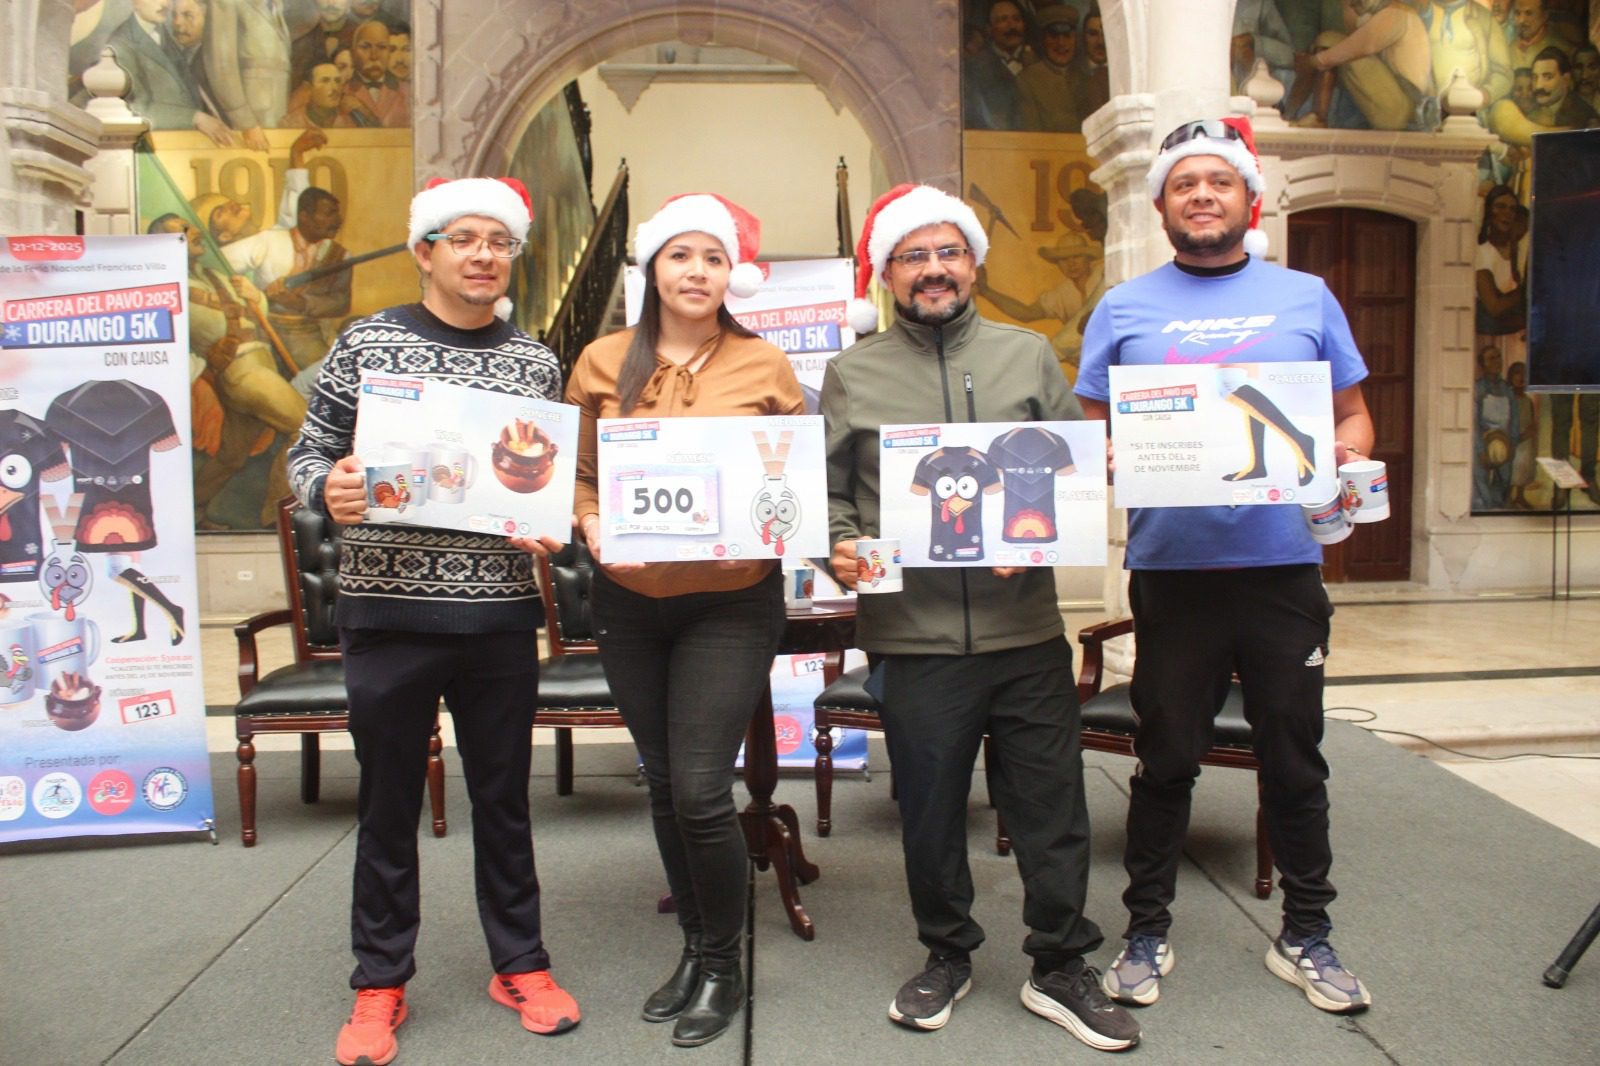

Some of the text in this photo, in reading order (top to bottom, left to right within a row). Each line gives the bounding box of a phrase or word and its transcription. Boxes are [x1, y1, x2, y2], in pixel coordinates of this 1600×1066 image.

[97, 263, 142, 272] Francisco
[6, 290, 178, 321] CARRERA DEL PAVO 2025
[761, 312, 783, 328] DEL
[784, 308, 816, 325] PAVO
[818, 307, 845, 322] 2025
[1161, 314, 1277, 334] NIKE
[27, 311, 159, 344] DURANGO 5K
[805, 325, 829, 349] 5K
[104, 350, 169, 367] CON CAUSA
[1150, 389, 1162, 399] DEL
[1163, 387, 1180, 398] PAVO
[1130, 397, 1188, 412] DURANGO 5K
[1158, 441, 1204, 449] INSCRIBES
[1137, 453, 1167, 461] ANTES
[1168, 453, 1185, 461] DEL
[1134, 464, 1201, 473] DE NOVIEMBRE
[632, 487, 694, 515] 500
[135, 702, 161, 719] 123
[25, 756, 96, 768] Presentada
